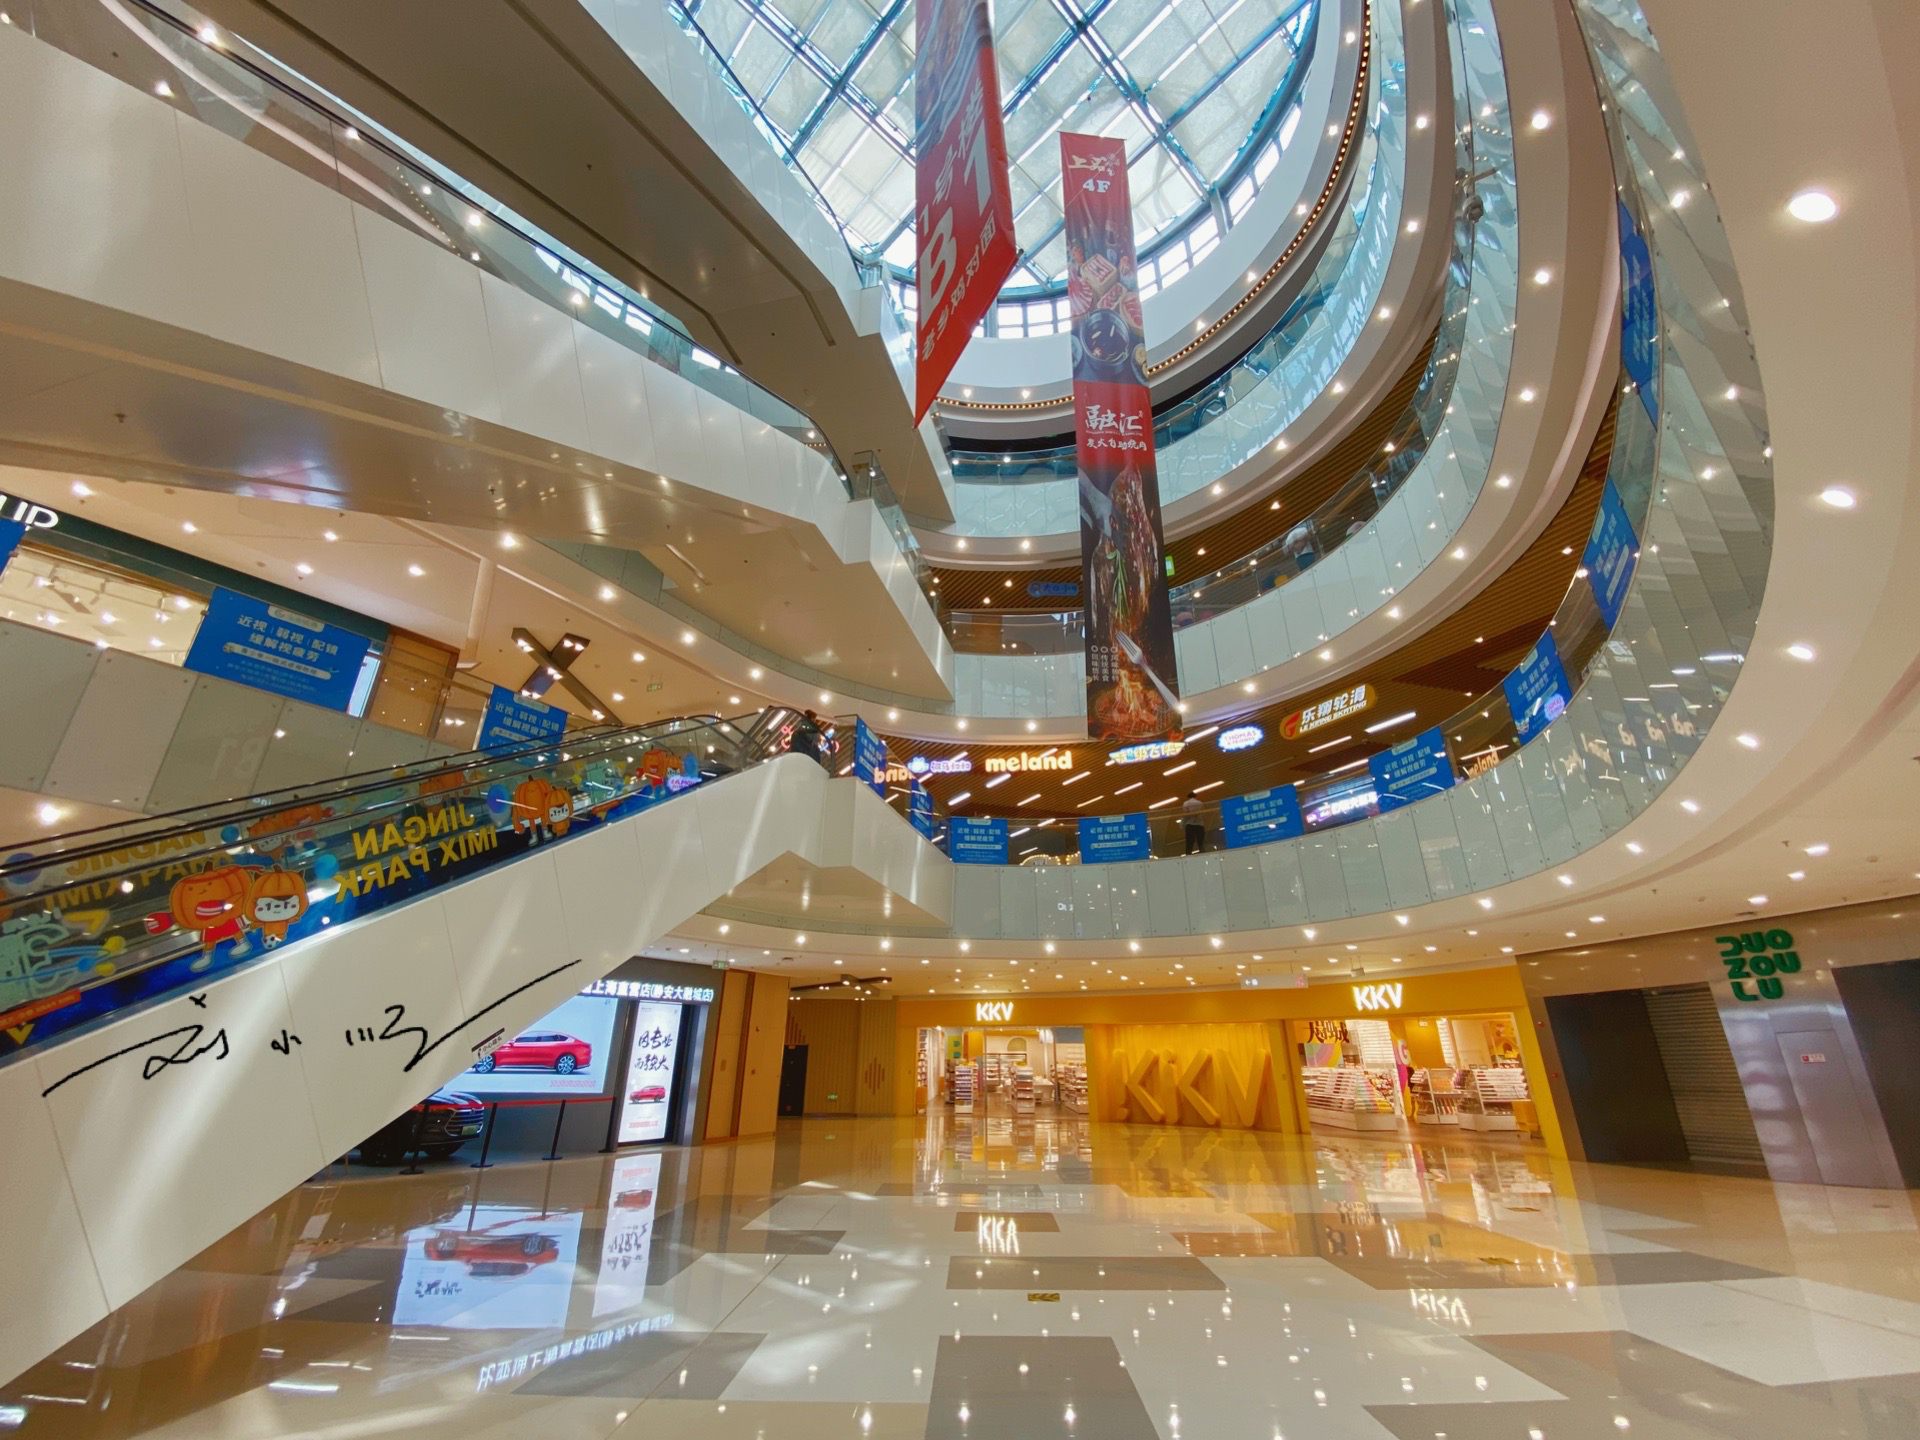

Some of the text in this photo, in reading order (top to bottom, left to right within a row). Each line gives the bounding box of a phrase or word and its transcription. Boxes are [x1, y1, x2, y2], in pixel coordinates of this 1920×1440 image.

[1083, 178, 1110, 193] 4F
[1085, 404, 1143, 433] 融汇
[1301, 684, 1366, 725] 乐翔轮滑
[985, 750, 1073, 773] meland
[1715, 928, 1794, 957] DUO
[1723, 951, 1802, 979] ZOU
[1353, 982, 1403, 1011] KKV
[1731, 977, 1784, 1002] LU
[975, 1001, 1014, 1022] KKV
[1112, 1048, 1272, 1127] KKV
